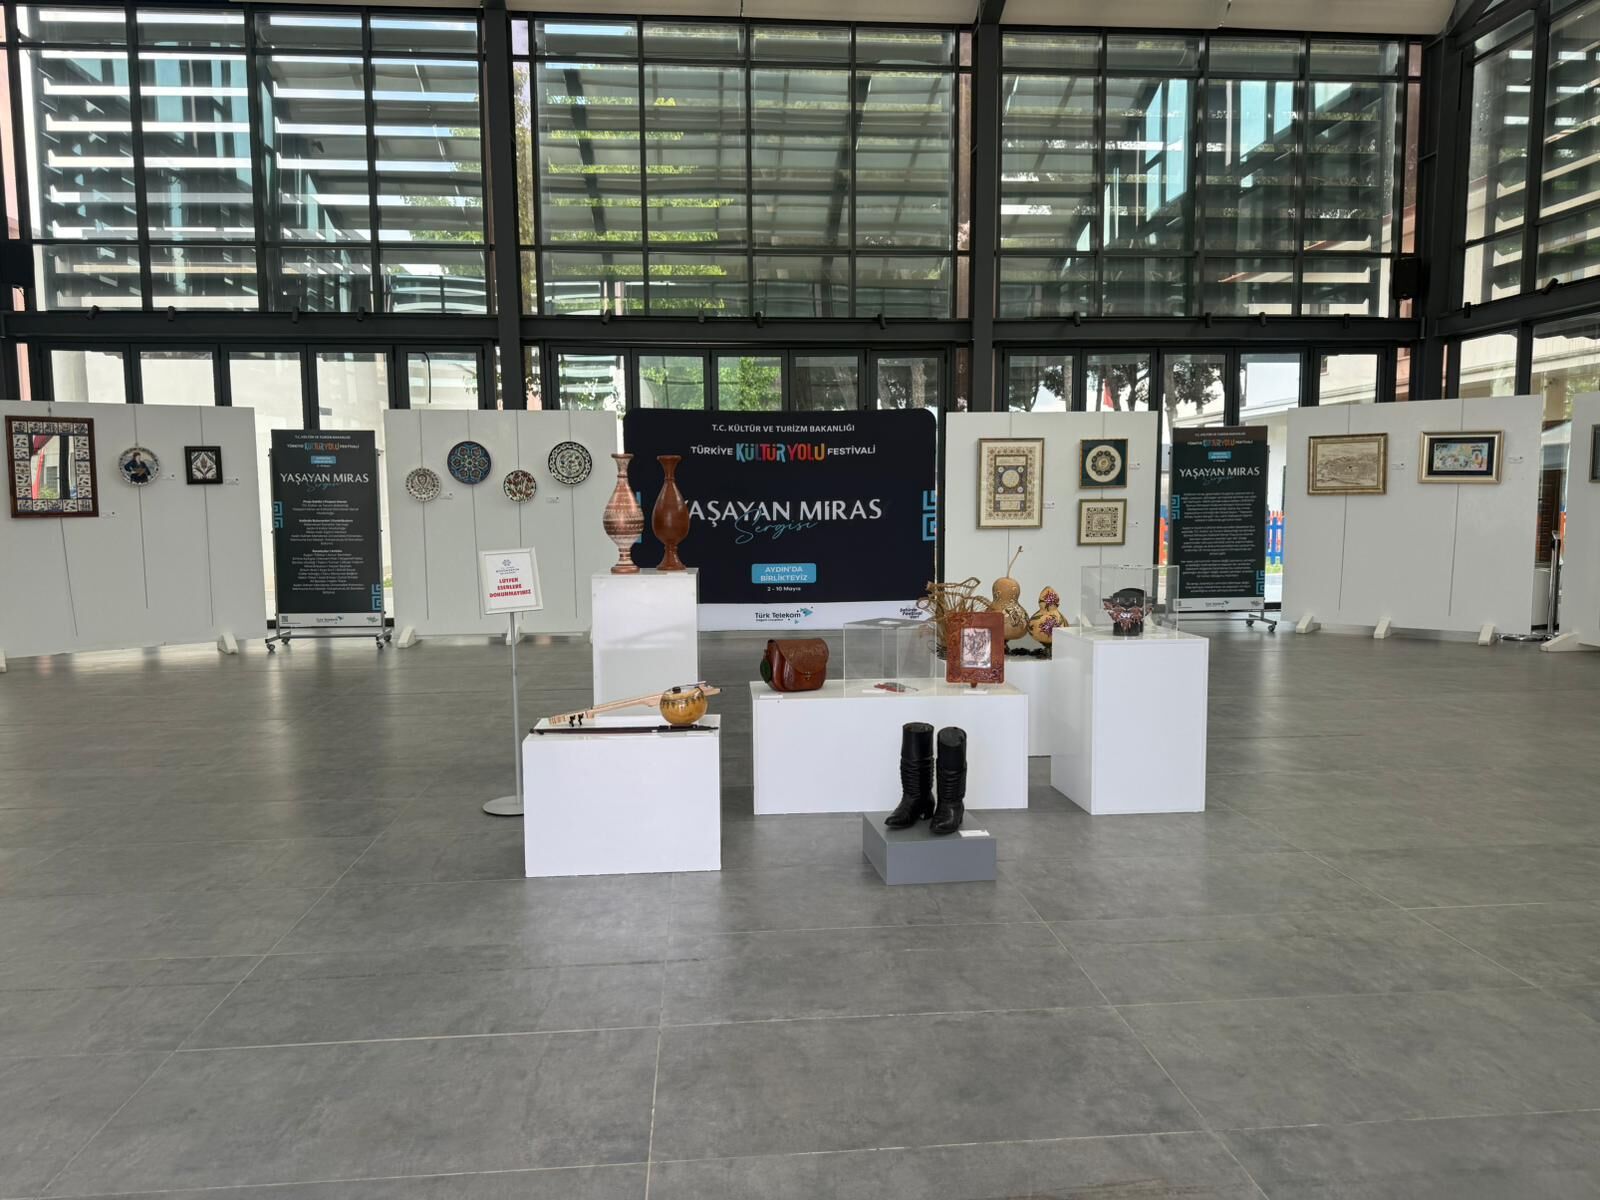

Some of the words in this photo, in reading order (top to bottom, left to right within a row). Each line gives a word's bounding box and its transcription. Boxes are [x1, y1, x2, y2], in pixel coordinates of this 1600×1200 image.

[712, 424, 727, 432] T.C.
[728, 424, 761, 433] KÜLTÜR
[763, 425, 774, 433] VE
[775, 423, 808, 433] TURİZM
[809, 423, 855, 433] BAKANLIĞI
[690, 444, 734, 456] TÜRKİYE
[735, 443, 786, 463] KÜLTÜR
[786, 443, 826, 462] YOLU
[827, 444, 876, 455] FESTİVALİ
[280, 472, 330, 485] YAŞAYAN
[1179, 467, 1225, 480] YAŞAYAN
[684, 499, 790, 527] AŞAYAN
[772, 611, 801, 619] Telekom
